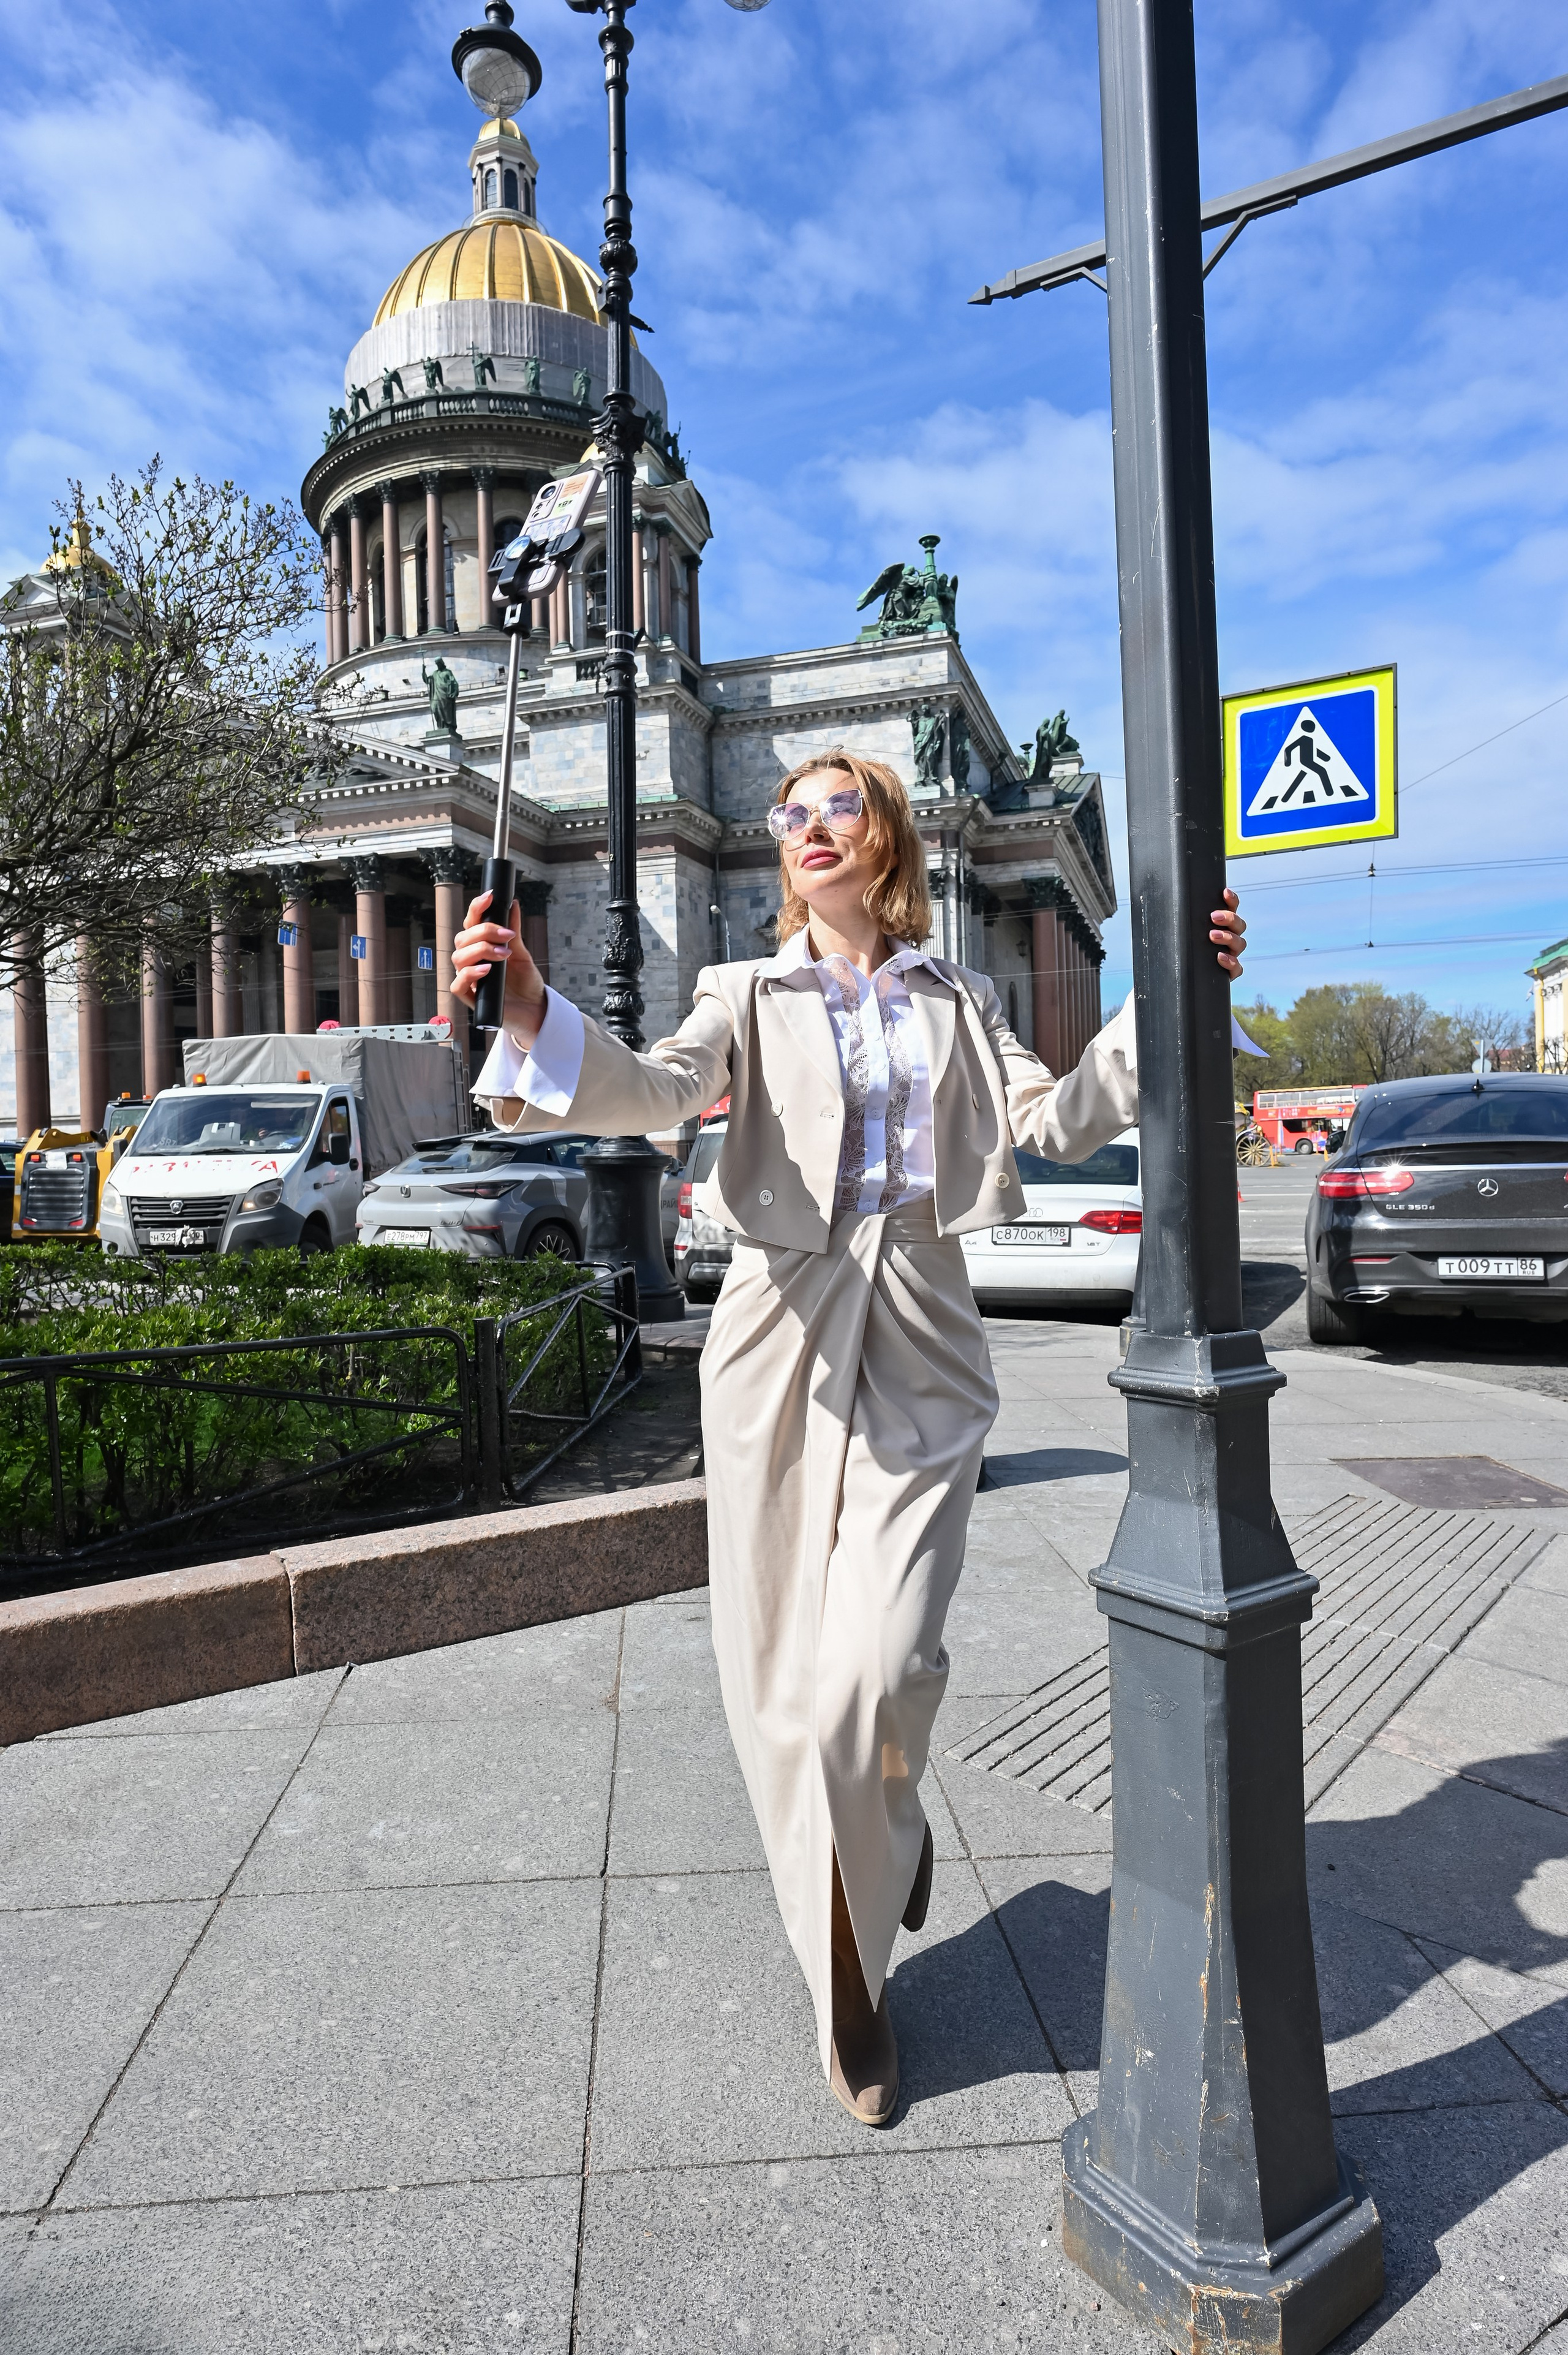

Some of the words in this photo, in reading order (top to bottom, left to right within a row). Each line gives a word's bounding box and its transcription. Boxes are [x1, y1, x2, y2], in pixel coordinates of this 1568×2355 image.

[661, 1198, 678, 1209] РАЙ
[996, 1228, 1044, 1241] С870ОК
[1047, 1228, 1065, 1237] 198
[1520, 1258, 1537, 1270] 86
